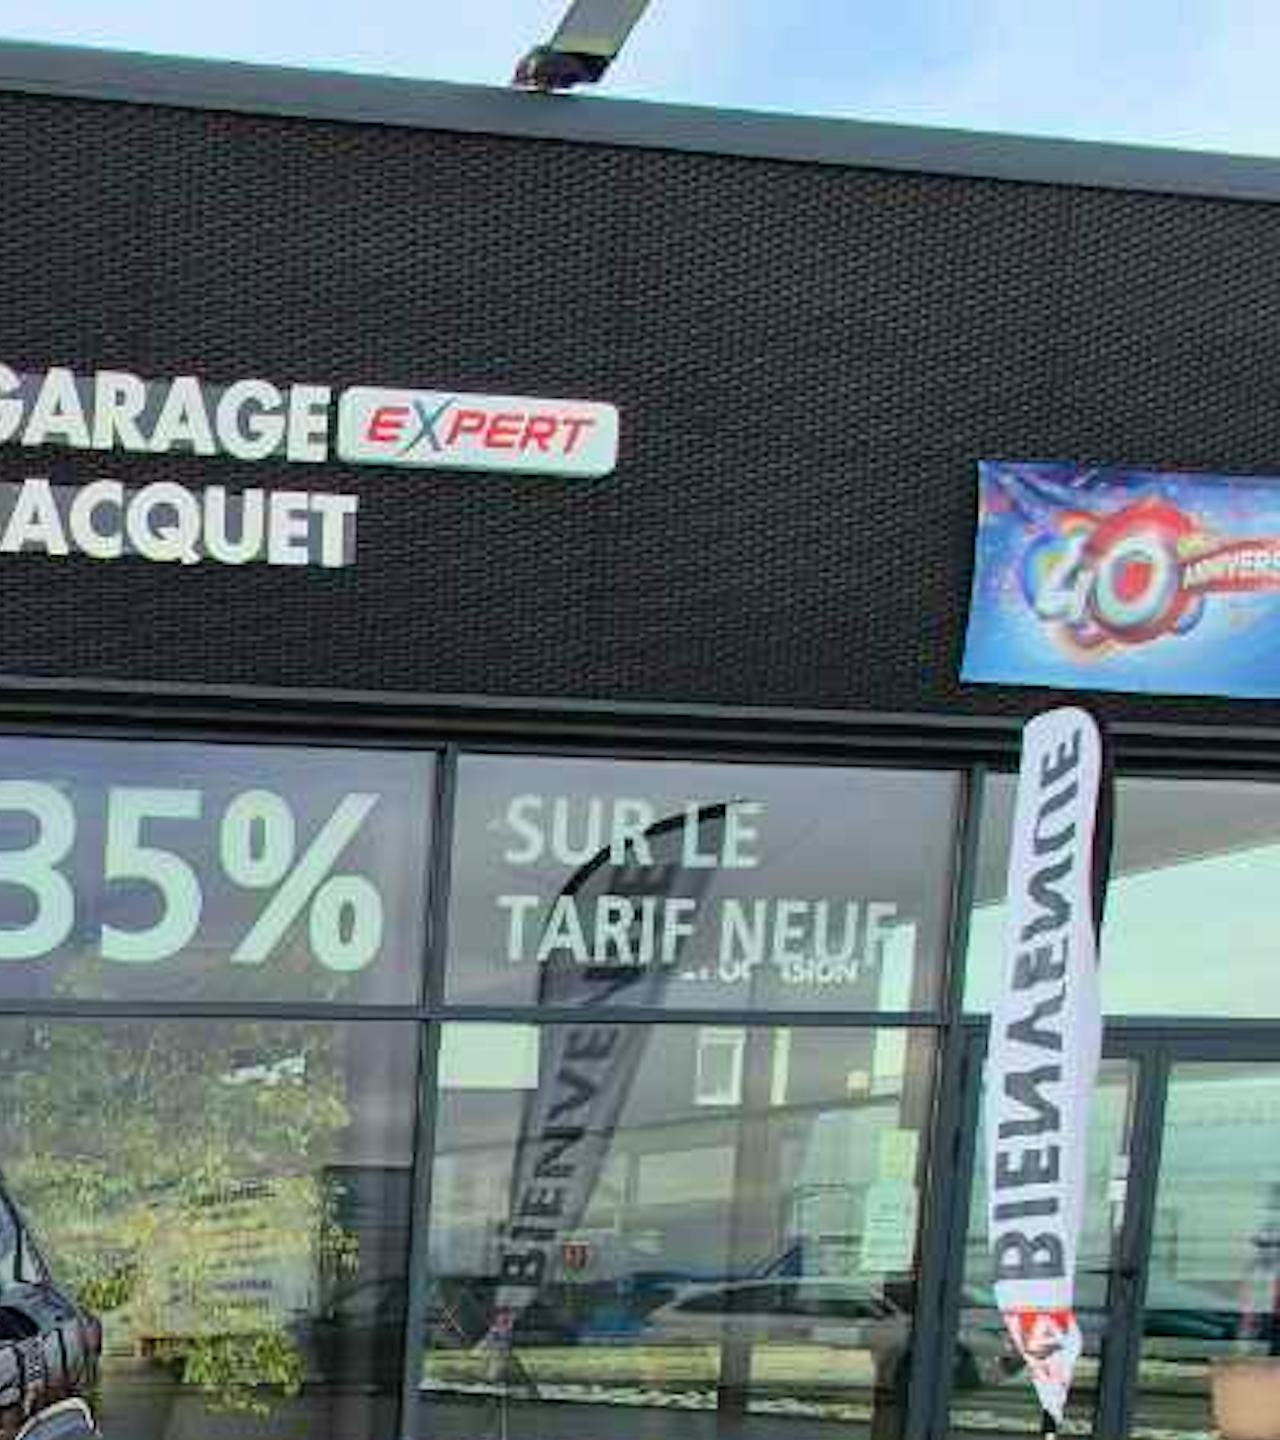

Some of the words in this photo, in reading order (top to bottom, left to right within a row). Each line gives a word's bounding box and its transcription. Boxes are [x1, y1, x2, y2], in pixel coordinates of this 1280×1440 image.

[504, 794, 654, 868] SUR
[681, 801, 766, 869] LE
[498, 895, 697, 964] TARIF
[719, 899, 897, 966] NEUF
